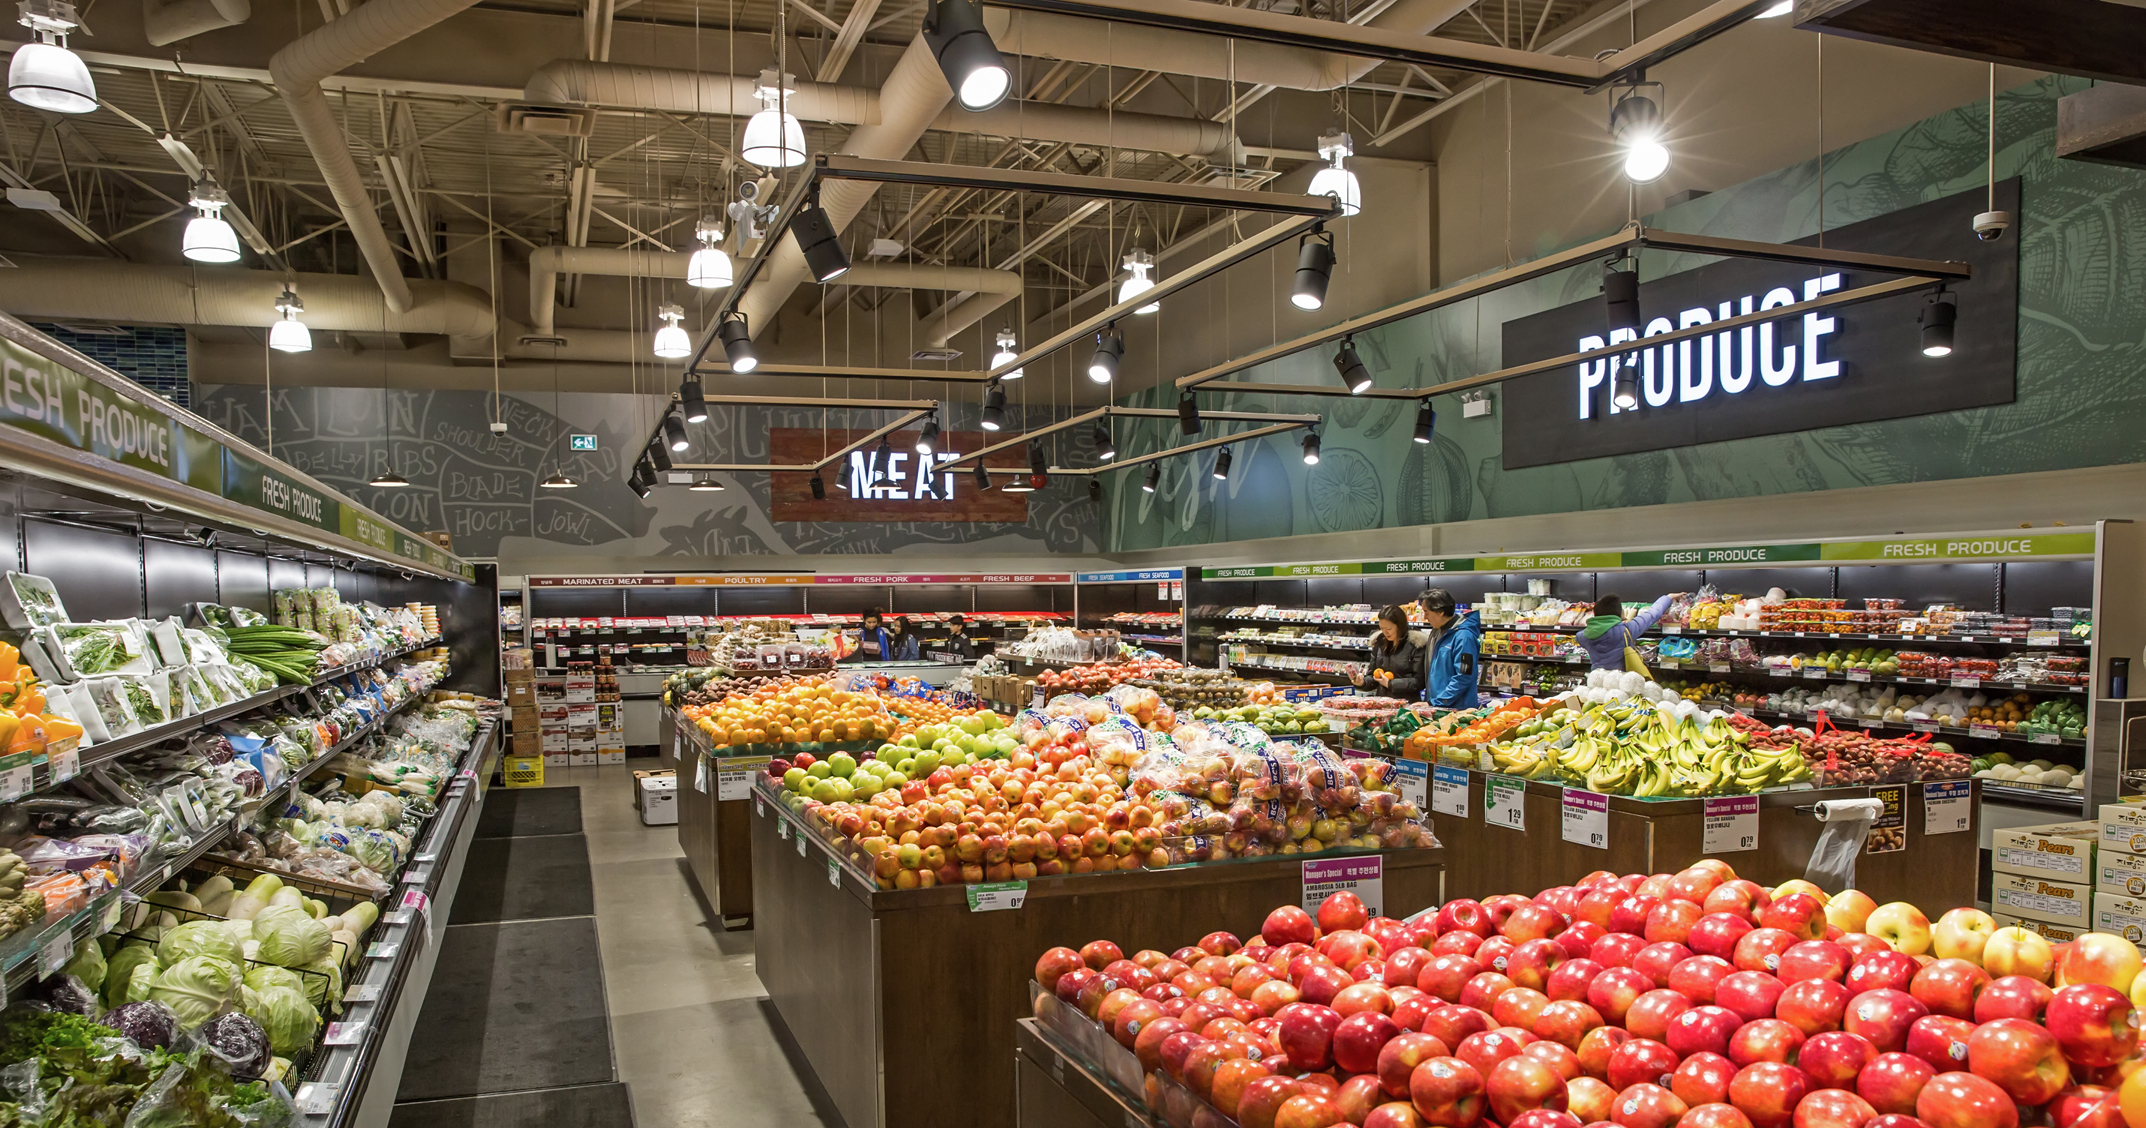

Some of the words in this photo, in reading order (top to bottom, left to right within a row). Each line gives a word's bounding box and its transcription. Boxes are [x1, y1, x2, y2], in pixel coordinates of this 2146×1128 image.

[1579, 272, 1841, 420] PRODUCE
[78, 389, 169, 467] PRODUCE
[499, 397, 556, 442] NECK
[434, 421, 526, 467] SHOULDER
[294, 443, 364, 473] BELLY
[373, 441, 438, 478] RIBS
[851, 450, 960, 500] MEAT
[450, 472, 525, 500] BLADE
[262, 475, 290, 512] FRESH
[292, 487, 322, 523] PRODUCE
[538, 509, 594, 546] JOWL
[1664, 552, 1701, 563] FRESH
[1708, 549, 1767, 562] PRODUCE
[1884, 543, 1937, 557] FRESH
[1947, 540, 2032, 555] PRODUCE
[1293, 566, 1310, 575] FRESH
[1313, 565, 1339, 574] PRODUCE
[1386, 563, 1409, 572] FRESH
[1412, 561, 1445, 571] PRODUCE
[1506, 558, 1534, 568] FRESH
[1539, 557, 1582, 567] PRODUCE
[1234, 569, 1255, 577] PRODUCE
[563, 578, 615, 586] MARINATED
[1876, 790, 1899, 802] FREE
[2038, 839, 2075, 856] Pears
[1327, 868, 1343, 878] Special
[1306, 883, 1334, 891] AMBROSIA
[2037, 882, 2074, 899] Pears
[2038, 924, 2075, 942] Pears
